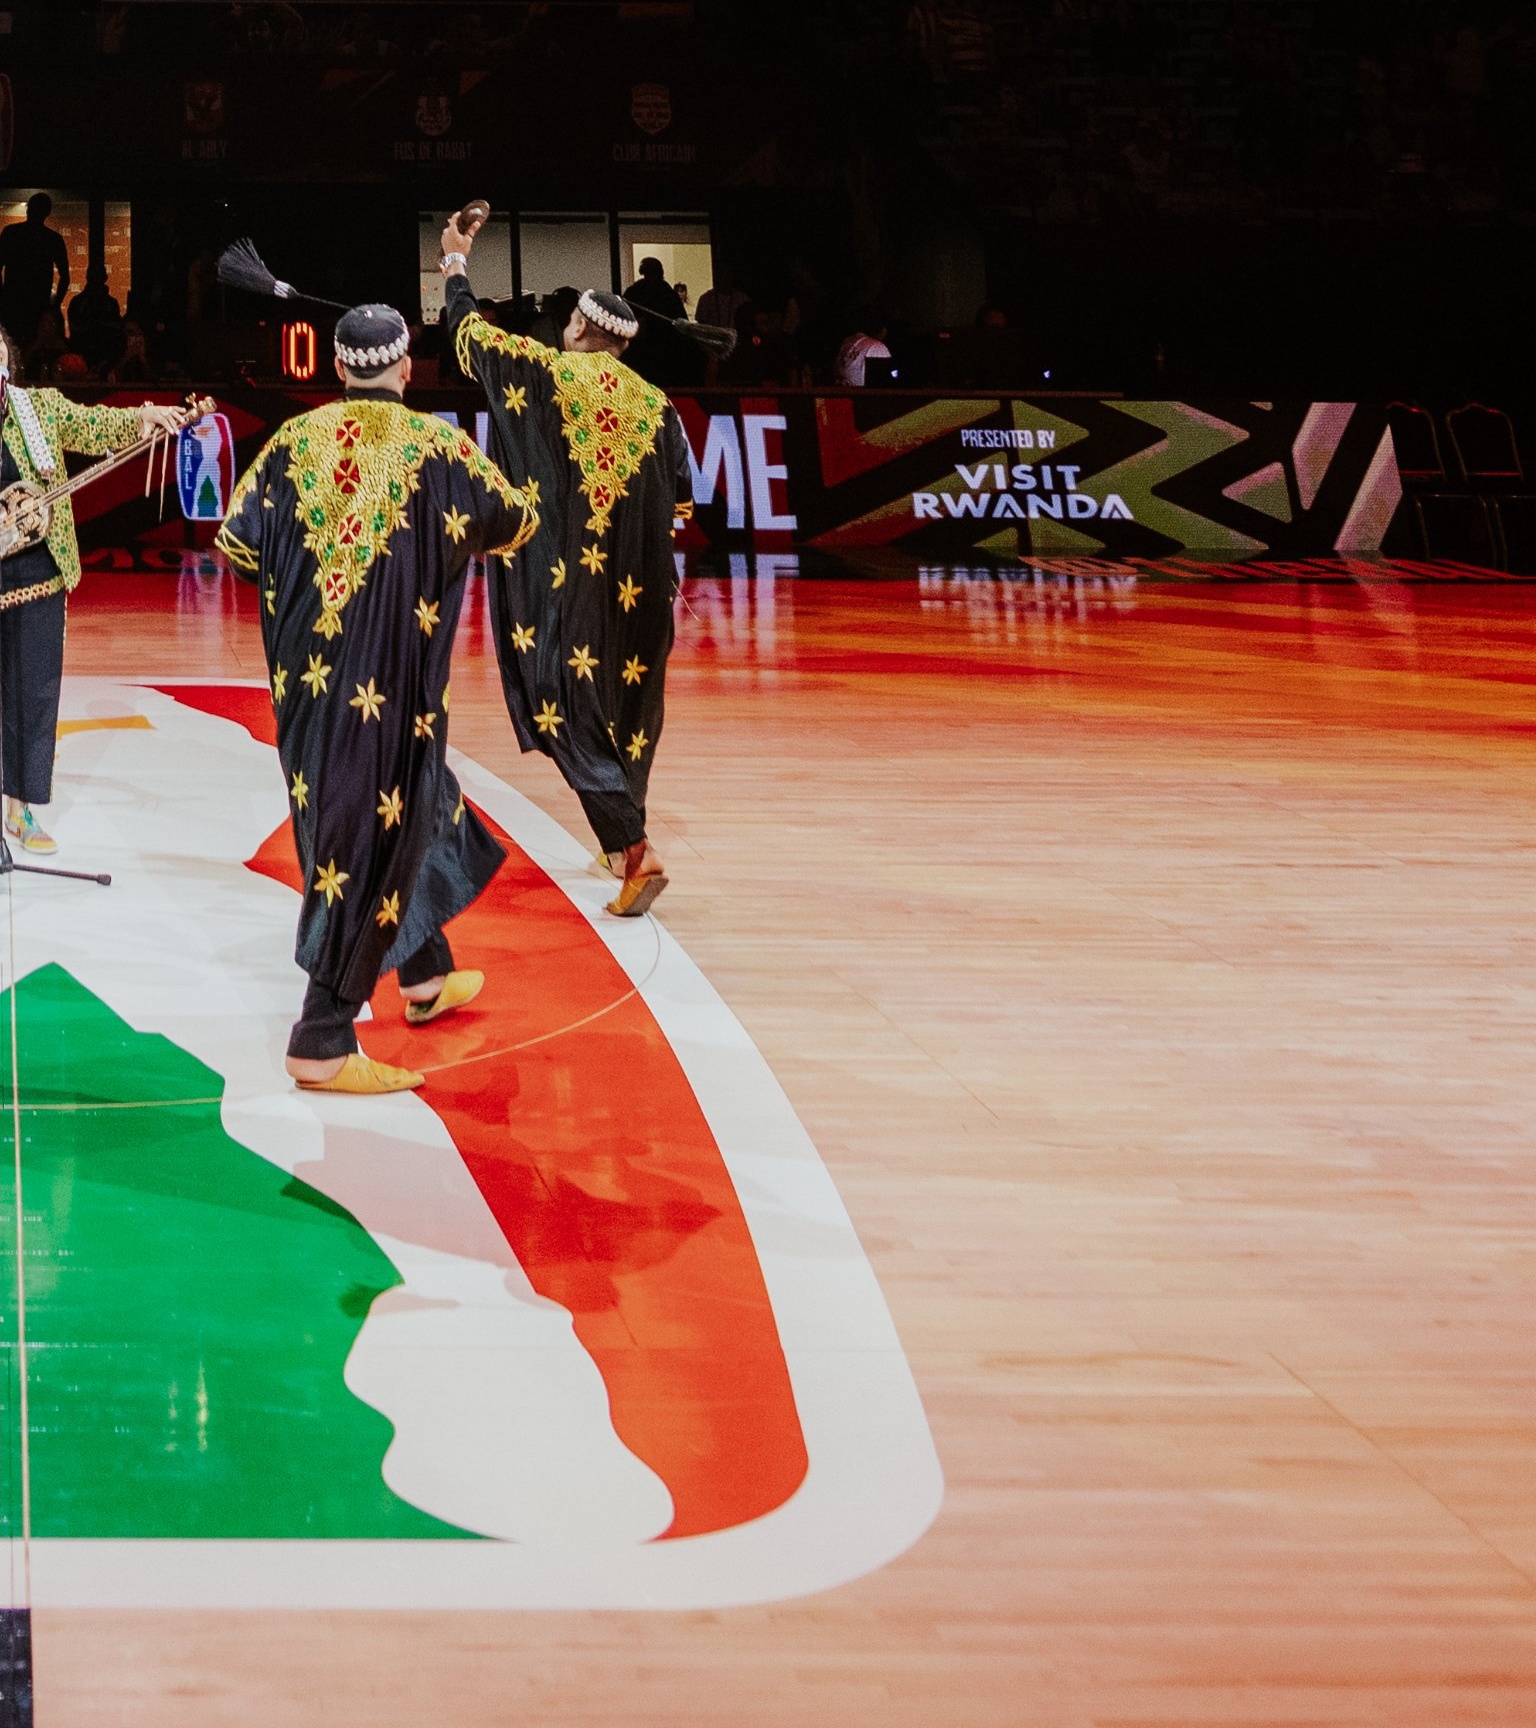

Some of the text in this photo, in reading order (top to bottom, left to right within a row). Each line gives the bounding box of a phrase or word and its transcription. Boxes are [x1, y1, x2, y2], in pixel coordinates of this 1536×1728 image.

[289, 321, 316, 379] 0
[960, 429, 1057, 450] PRESENTED BY
[183, 438, 193, 490] BAL
[954, 463, 1081, 491] VISIT
[912, 492, 1135, 520] RWANDA
